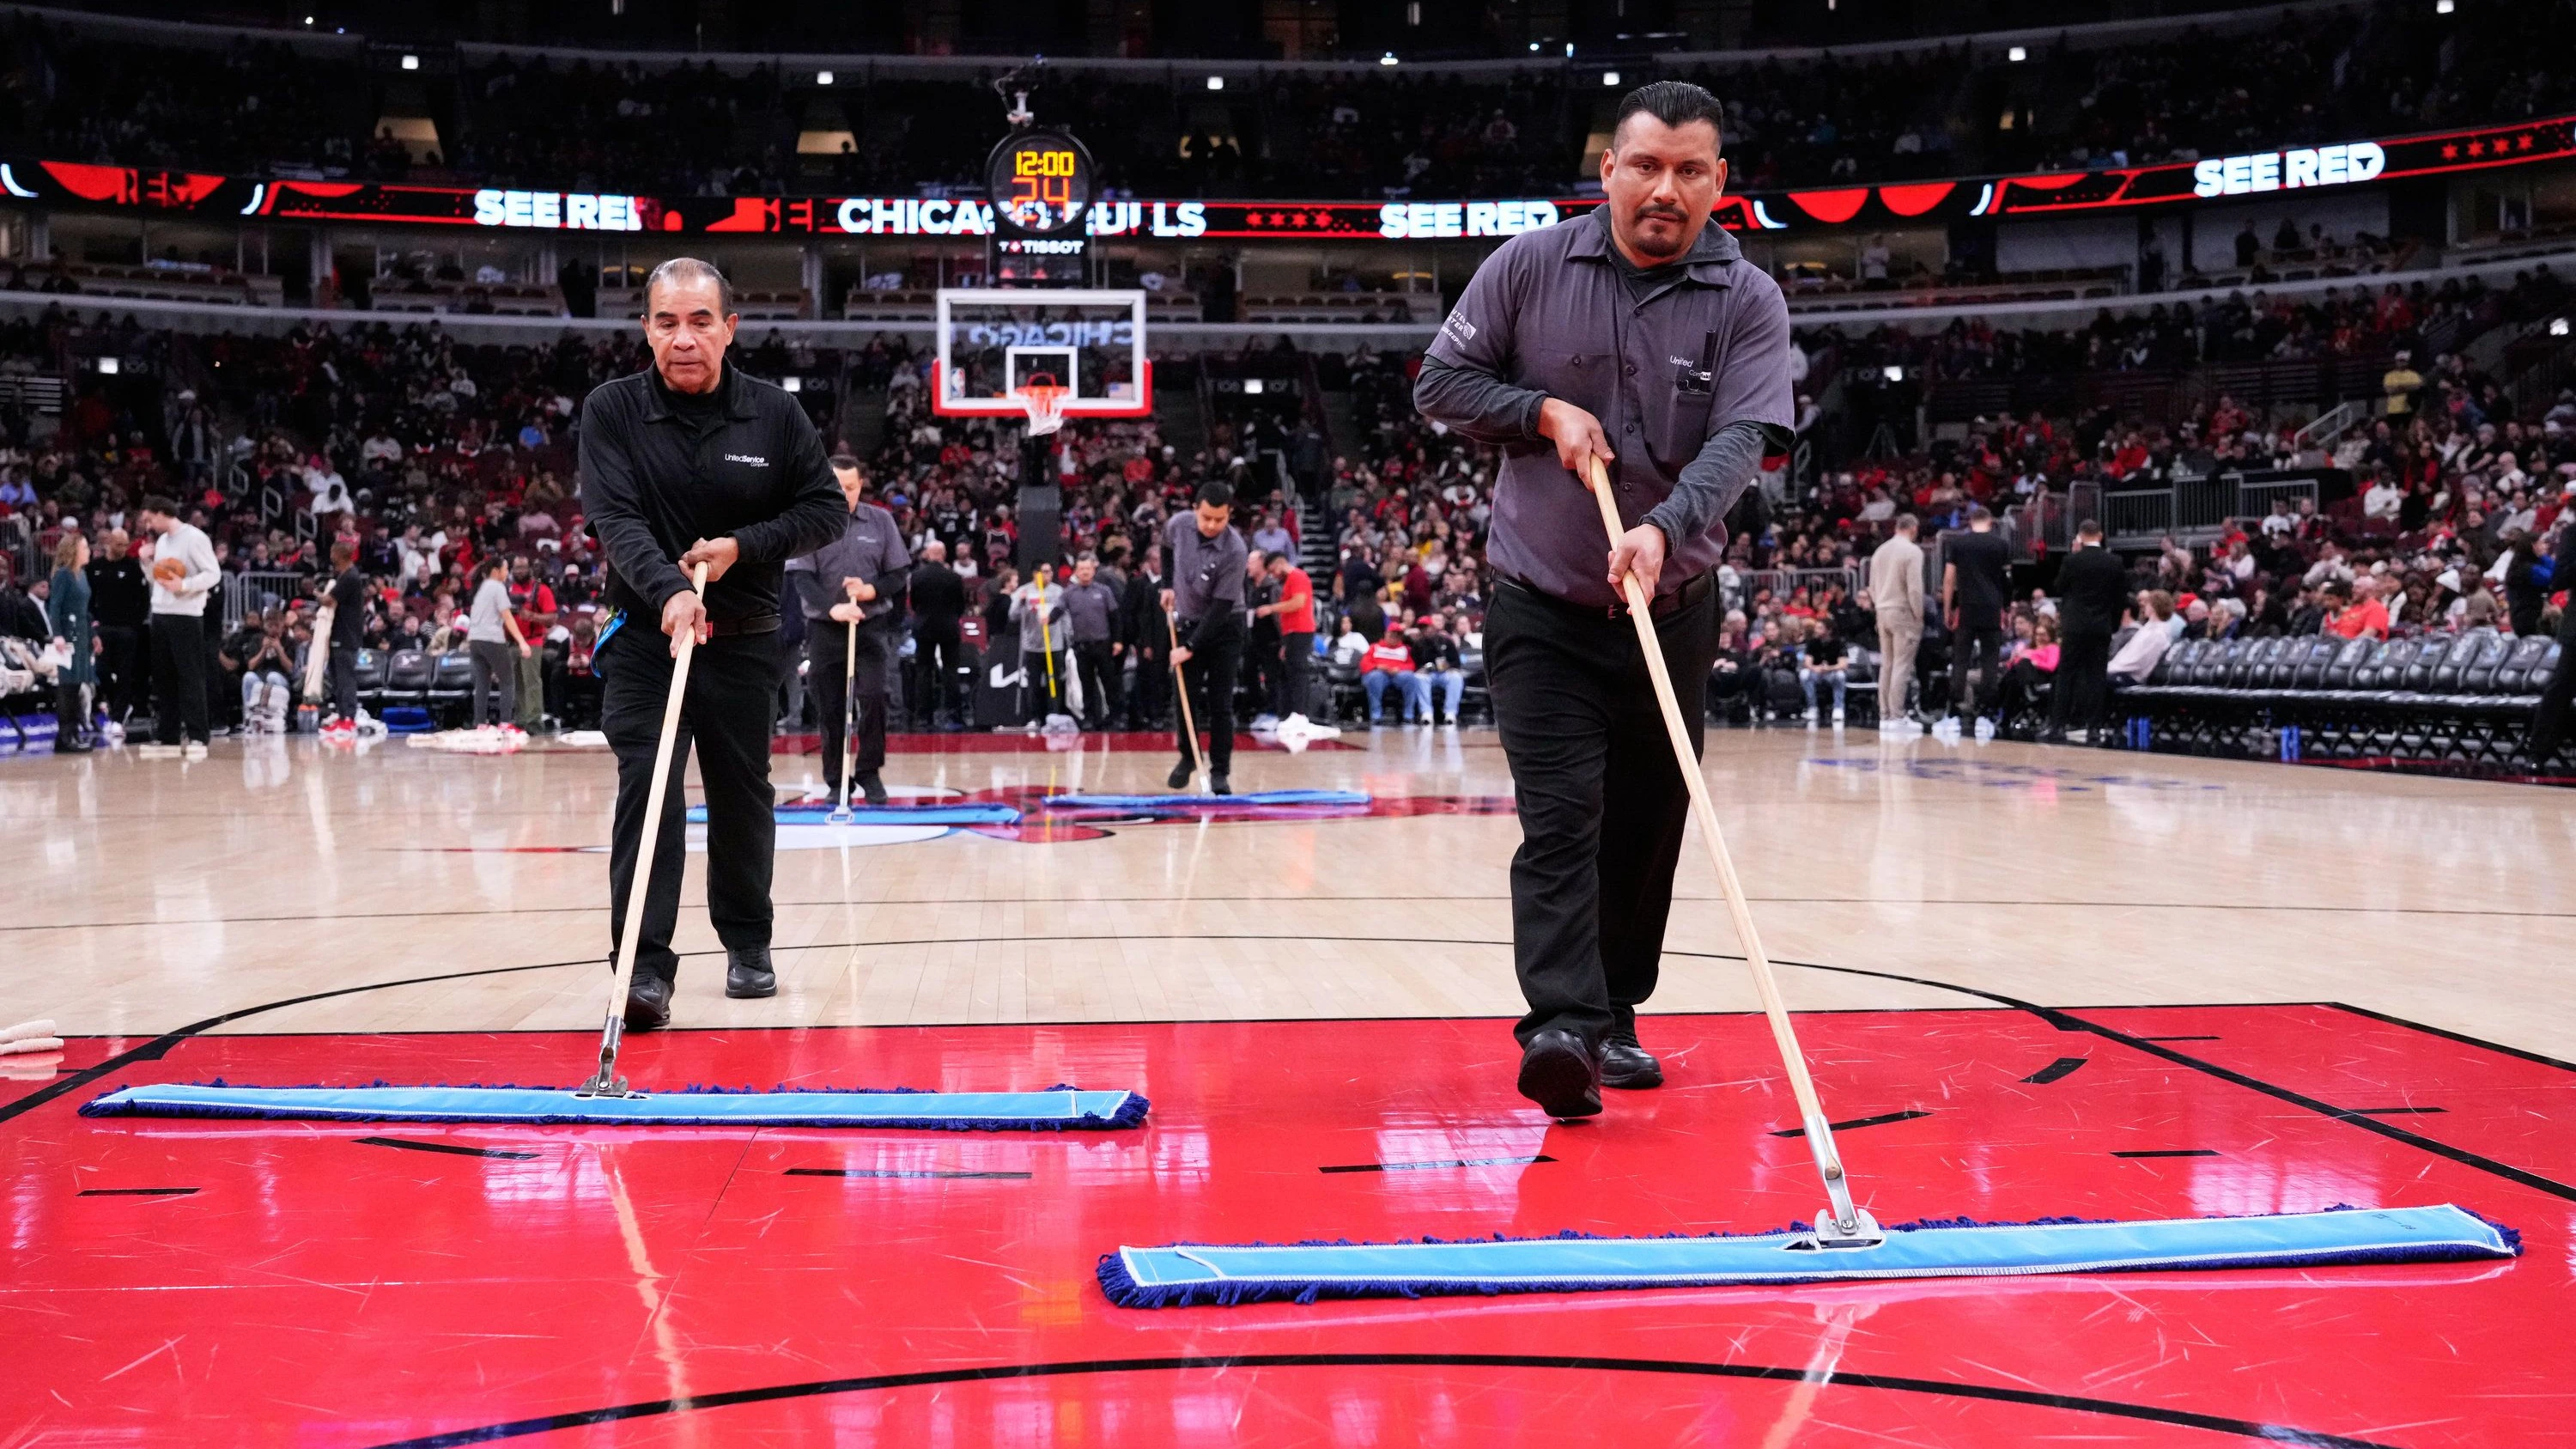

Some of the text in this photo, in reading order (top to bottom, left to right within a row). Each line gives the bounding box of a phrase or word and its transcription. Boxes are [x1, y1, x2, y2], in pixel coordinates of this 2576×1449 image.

[1016, 150, 1074, 176] 12:00
[2194, 142, 2385, 197] SEE RED
[474, 189, 560, 228] SEE
[1012, 177, 1071, 223] 24
[1379, 201, 1558, 239] SEE RED
[1669, 355, 1694, 368] United
